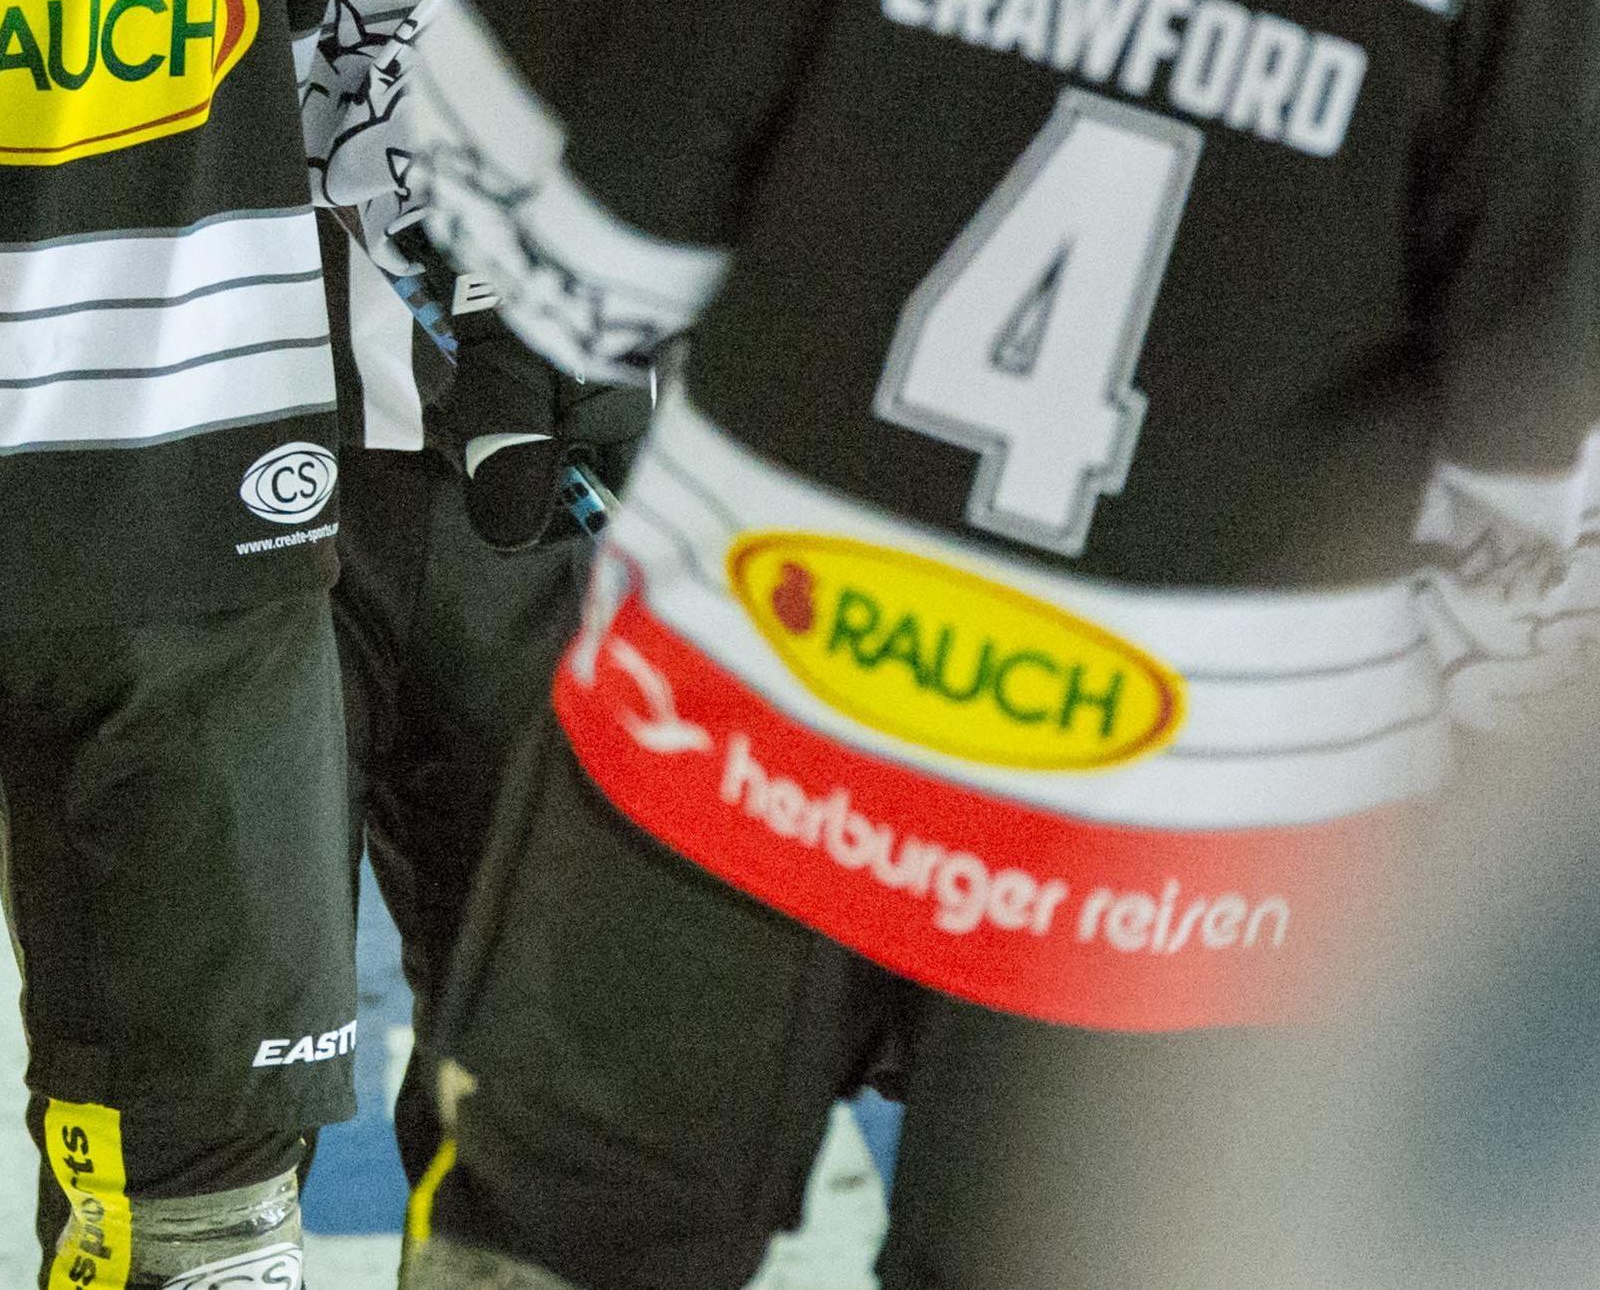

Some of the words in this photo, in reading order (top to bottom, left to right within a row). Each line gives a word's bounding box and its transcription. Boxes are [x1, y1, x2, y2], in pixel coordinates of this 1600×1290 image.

[874, 86, 1203, 558] 4
[271, 461, 318, 504] CS
[825, 587, 1123, 740] RAUCH
[720, 734, 1067, 936] herburger
[1079, 877, 1291, 954] reisen
